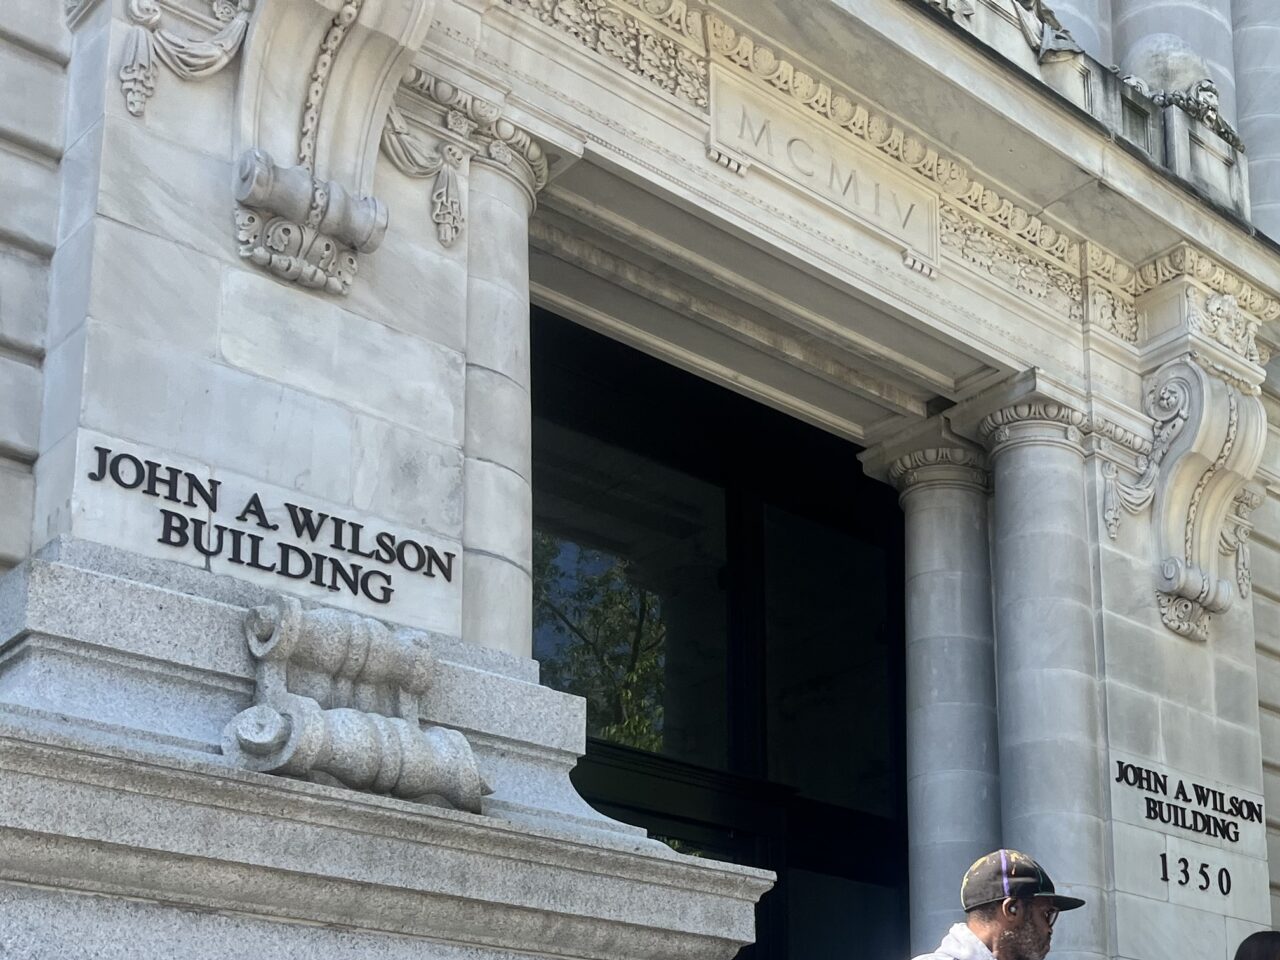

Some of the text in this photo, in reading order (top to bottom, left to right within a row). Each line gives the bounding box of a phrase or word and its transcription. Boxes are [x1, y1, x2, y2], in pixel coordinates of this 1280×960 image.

[737, 105, 915, 229] MCMIV
[87, 446, 456, 582] JOHN A. WILSON
[158, 508, 395, 604] BUILDING
[1115, 760, 1263, 824] JOHN A. WILSON
[1144, 796, 1240, 842] BUILDING
[1159, 852, 1232, 896] 1350
